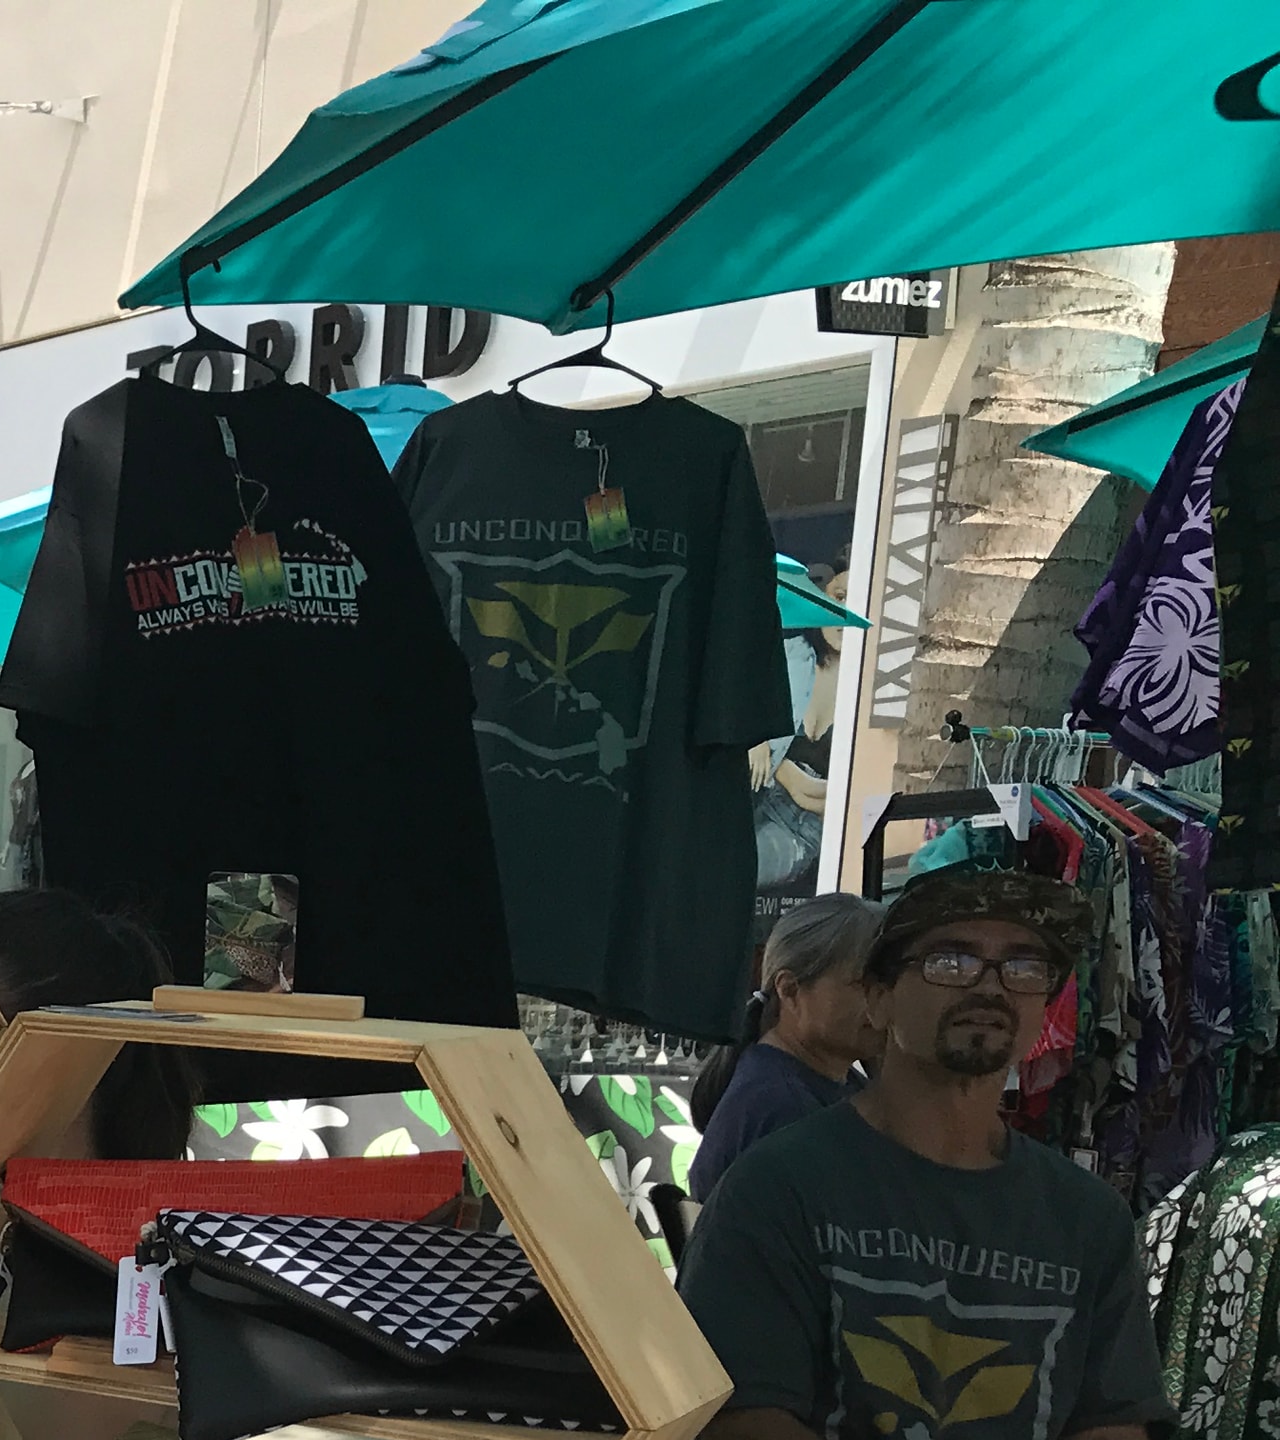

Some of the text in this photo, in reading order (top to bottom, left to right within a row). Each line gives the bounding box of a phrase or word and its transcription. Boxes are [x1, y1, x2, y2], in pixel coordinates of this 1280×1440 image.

[841, 277, 942, 308] zumiez
[435, 517, 687, 558] UNCONQRED
[137, 600, 205, 631] ALWAYS
[298, 600, 339, 616] WILL
[341, 602, 360, 617] BE
[813, 1223, 1082, 1296] UNCONQUERED
